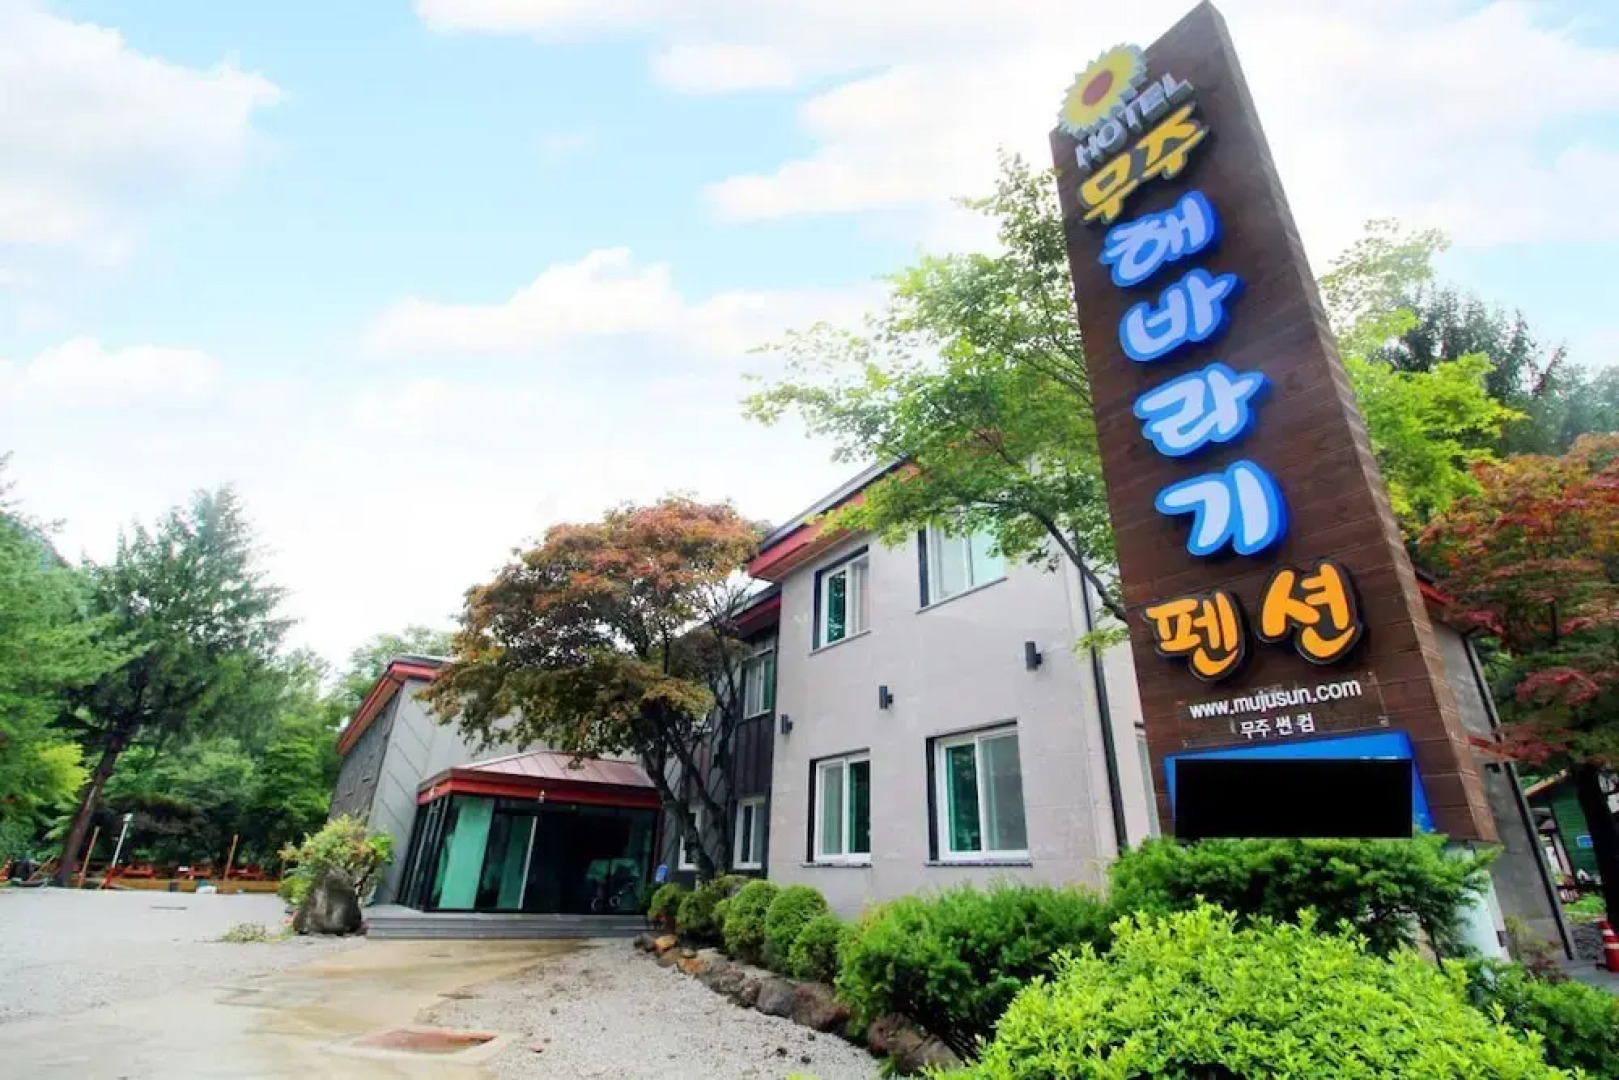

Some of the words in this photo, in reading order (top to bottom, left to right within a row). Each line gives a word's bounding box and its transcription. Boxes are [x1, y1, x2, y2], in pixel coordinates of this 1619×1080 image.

[1075, 72, 1193, 170] HOTEL
[1079, 103, 1208, 223] 무주
[1102, 190, 1284, 556] 해바라기
[1144, 561, 1357, 677] 펜션
[1189, 679, 1362, 719] www.mujusun.com
[1240, 718, 1272, 739] 무주
[1275, 716, 1294, 736] 썬
